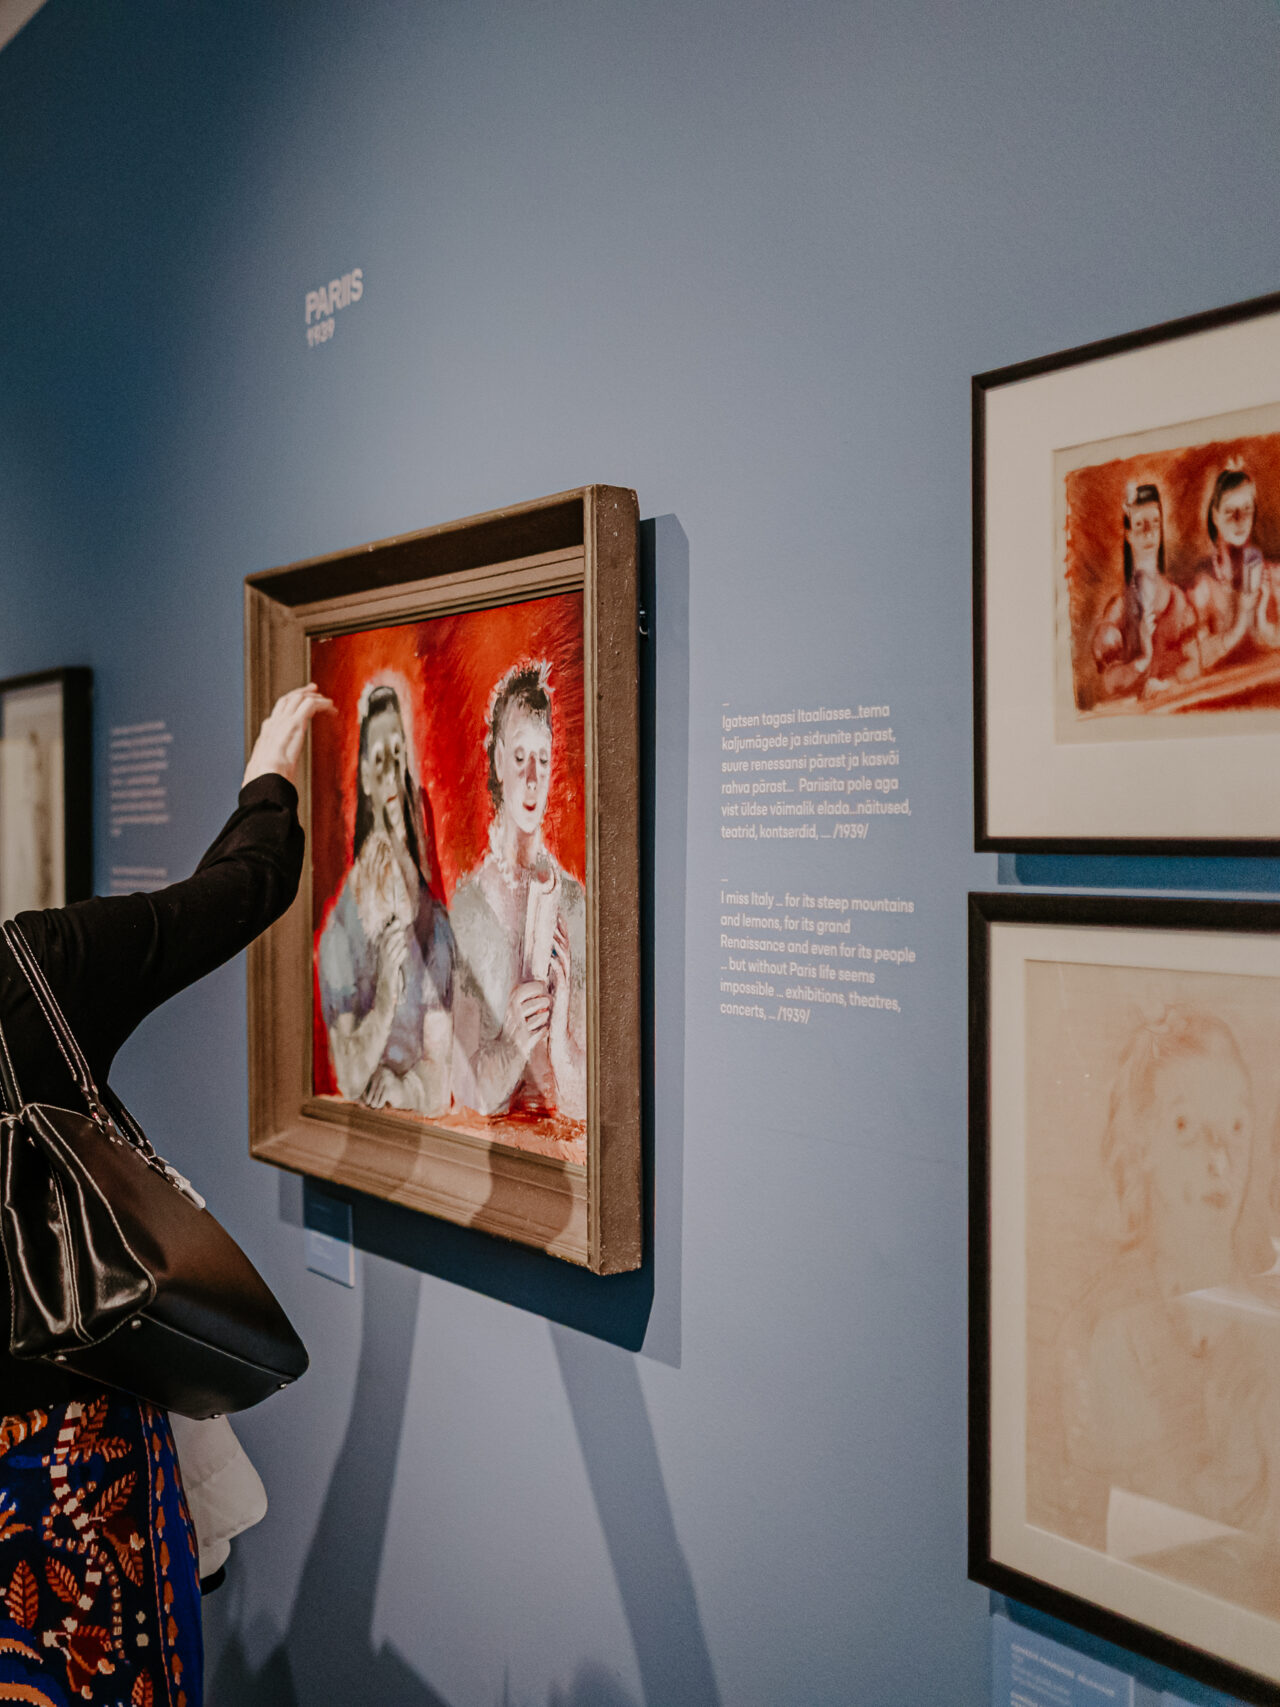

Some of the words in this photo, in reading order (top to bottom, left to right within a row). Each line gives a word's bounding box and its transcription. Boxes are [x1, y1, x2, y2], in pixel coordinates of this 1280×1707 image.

[722, 715, 760, 732] Igatsen
[761, 709, 796, 729] tagasi
[789, 732, 801, 750] ja
[803, 729, 852, 746] sidrunite
[721, 760, 749, 773] suure
[750, 754, 807, 771] renessansi
[846, 752, 859, 771] ja
[721, 780, 750, 795] rahva
[798, 776, 845, 792] Pariisita
[846, 776, 872, 794] pole
[874, 777, 899, 794] aga
[721, 803, 739, 817] vist
[721, 824, 758, 841] teatrid,
[759, 824, 819, 841] kontserdid,
[720, 890, 725, 904] I
[726, 891, 750, 906] miss
[751, 891, 775, 910] Italy
[785, 892, 801, 908] for
[802, 894, 816, 909] its
[817, 897, 849, 913] steep
[851, 897, 915, 913] mountains
[720, 913, 741, 927] and
[742, 913, 782, 931] lemons,
[783, 915, 800, 930] for
[801, 916, 815, 931] its
[816, 919, 851, 936] grand
[720, 934, 786, 953] Renaissance
[788, 939, 809, 954] and
[810, 944, 838, 957] even
[839, 942, 857, 958] for
[858, 943, 872, 959] its
[874, 947, 916, 966] people
[728, 957, 747, 972] but
[748, 958, 787, 975] without
[789, 962, 817, 979] Paris
[819, 964, 836, 980] life
[838, 969, 876, 984] seems
[720, 978, 775, 998] impossible
[785, 985, 848, 1007] exhibitions,
[849, 991, 902, 1013] theatres,
[720, 1002, 767, 1021] concerts,
